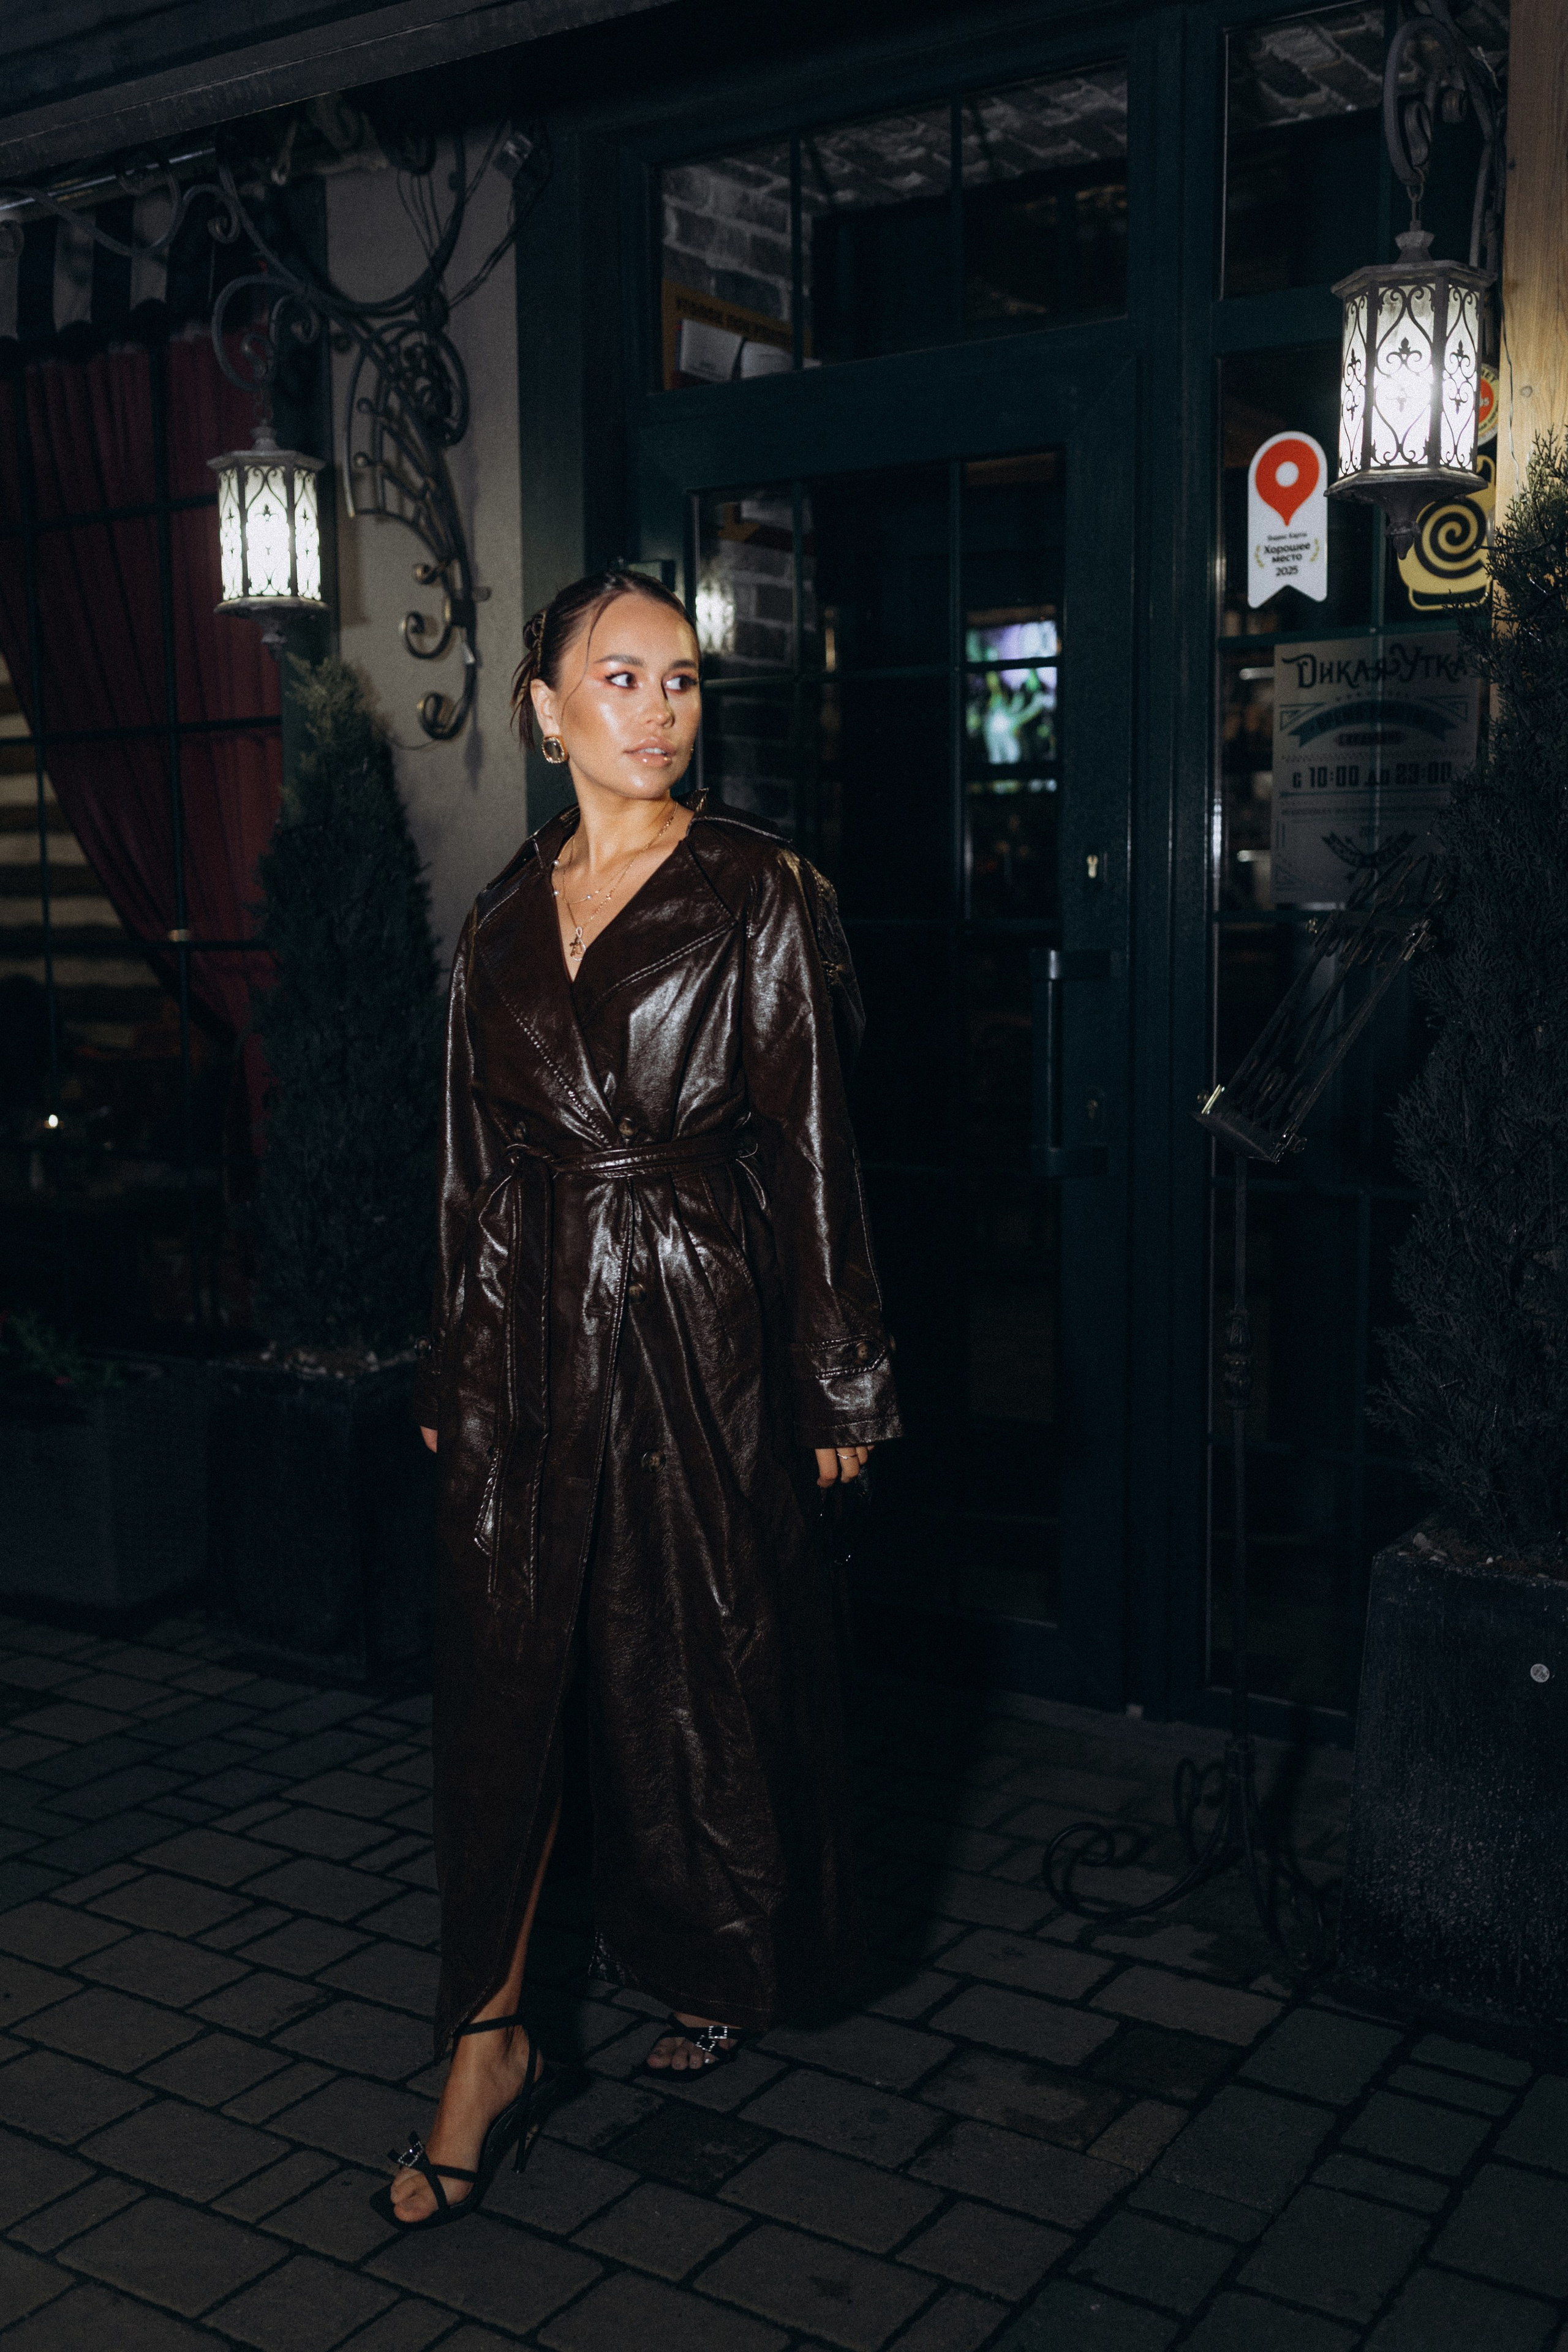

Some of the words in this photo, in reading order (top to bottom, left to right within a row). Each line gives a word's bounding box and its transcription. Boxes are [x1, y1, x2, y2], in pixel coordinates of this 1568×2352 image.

[1264, 543, 1310, 554] Хорошее
[1272, 554, 1302, 563] место
[1276, 565, 1298, 576] 2025
[1310, 766, 1360, 788] 10:00
[1395, 761, 1452, 785] 23:00
